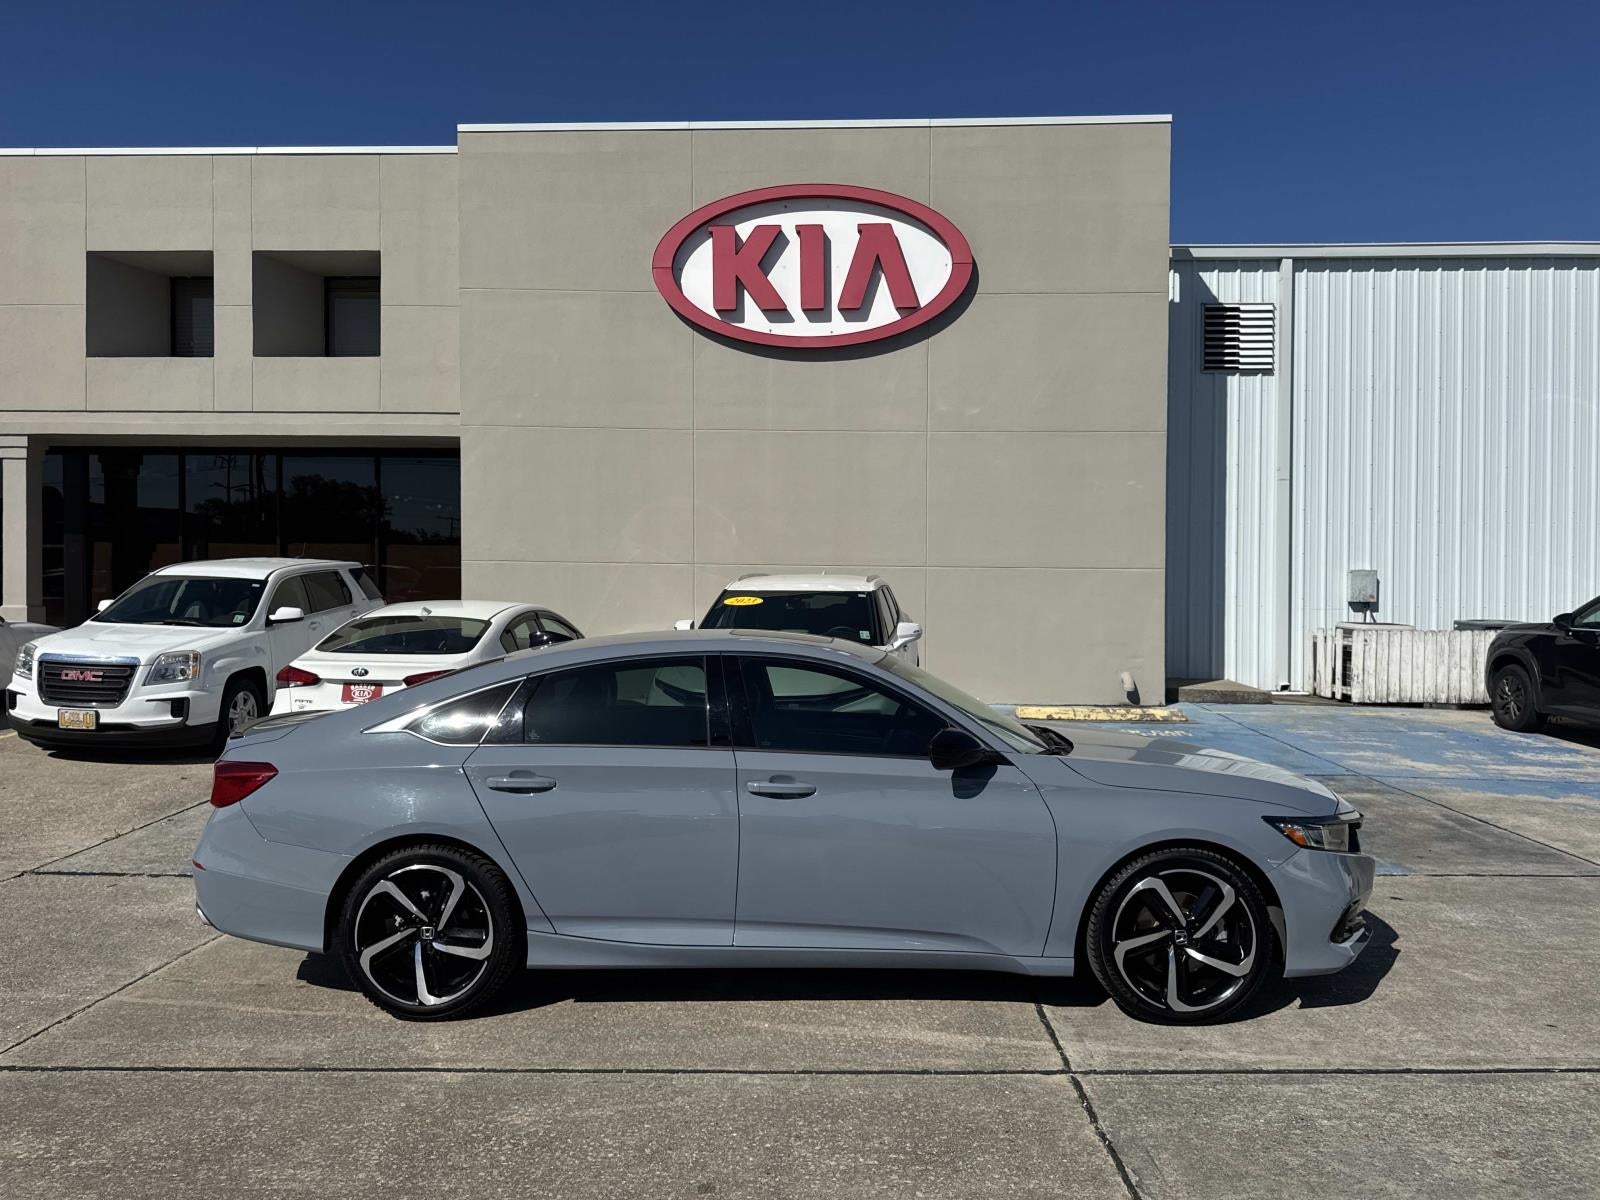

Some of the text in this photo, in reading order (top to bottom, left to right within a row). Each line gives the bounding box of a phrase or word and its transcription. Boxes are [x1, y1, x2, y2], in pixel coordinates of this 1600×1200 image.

[708, 223, 921, 311] KIA
[61, 670, 104, 681] GMC
[352, 668, 368, 677] KIA
